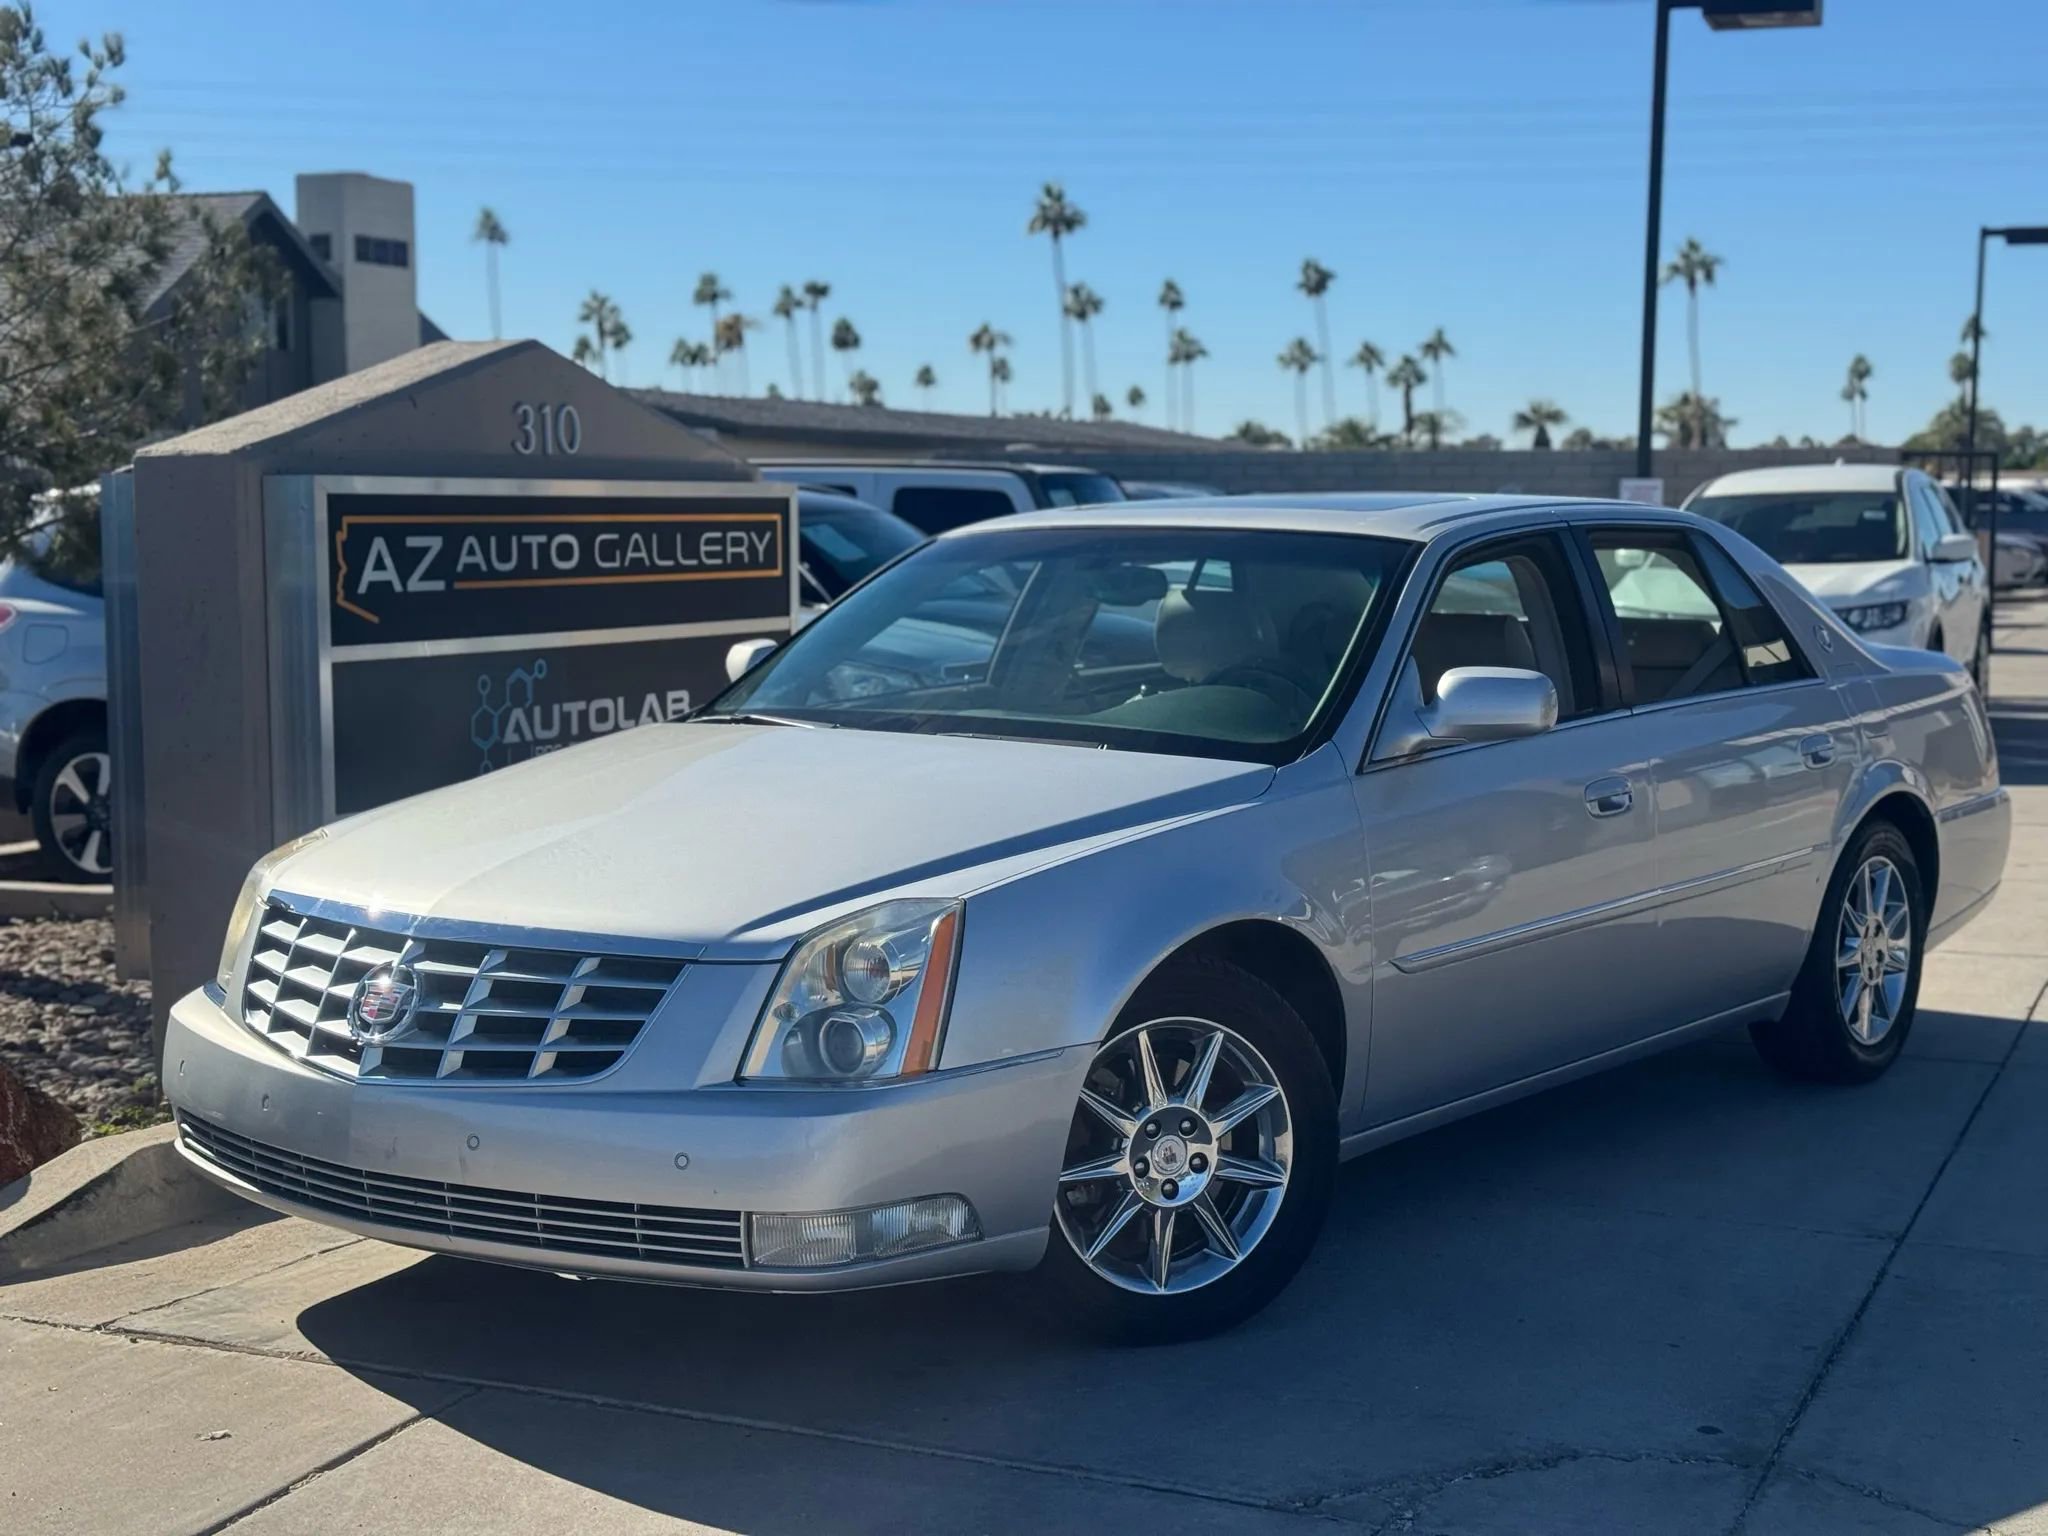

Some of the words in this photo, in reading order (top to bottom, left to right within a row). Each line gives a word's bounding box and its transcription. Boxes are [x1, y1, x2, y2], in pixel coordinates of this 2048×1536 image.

[514, 403, 581, 455] 310
[357, 536, 446, 594] AZ
[456, 533, 580, 573] AUTO
[594, 531, 771, 568] GALLERY
[502, 689, 690, 744] AUTOLAB
